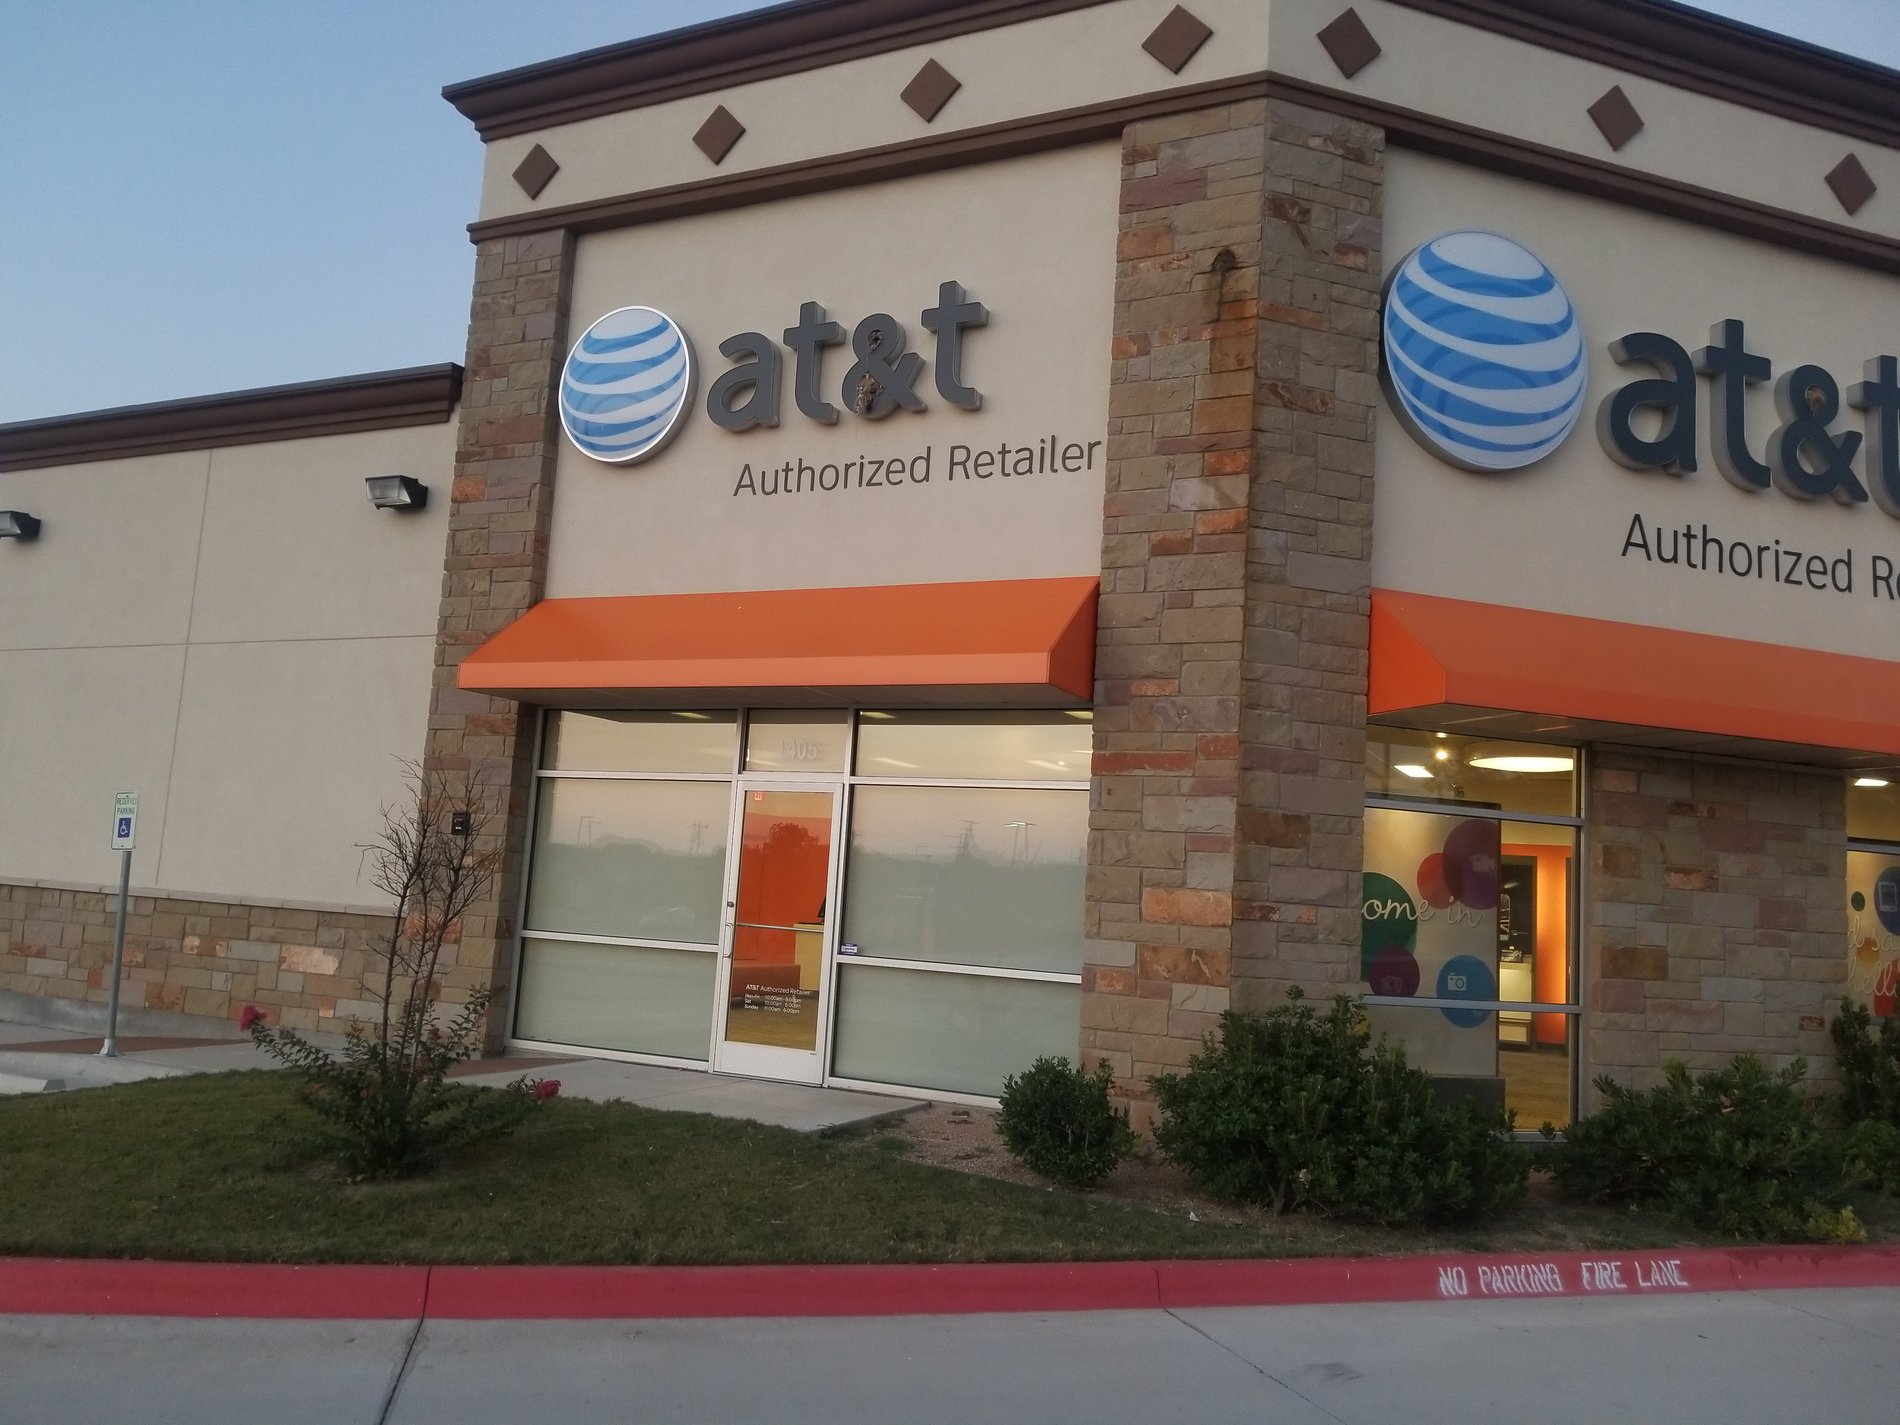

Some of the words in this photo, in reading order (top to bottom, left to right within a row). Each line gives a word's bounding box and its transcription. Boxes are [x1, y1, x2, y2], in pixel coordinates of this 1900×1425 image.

[706, 280, 989, 432] at&t
[733, 447, 931, 497] Authorized
[948, 434, 1102, 481] Retailer
[1621, 513, 1853, 594] Authorized
[1361, 898, 1436, 922] ome
[760, 985, 790, 994] Authorized
[790, 988, 810, 996] Retailer
[1438, 1266, 1468, 1296] NO
[1478, 1263, 1564, 1294] PARKING
[1580, 1261, 1627, 1290] FIRE
[1634, 1260, 1688, 1288] LANE
